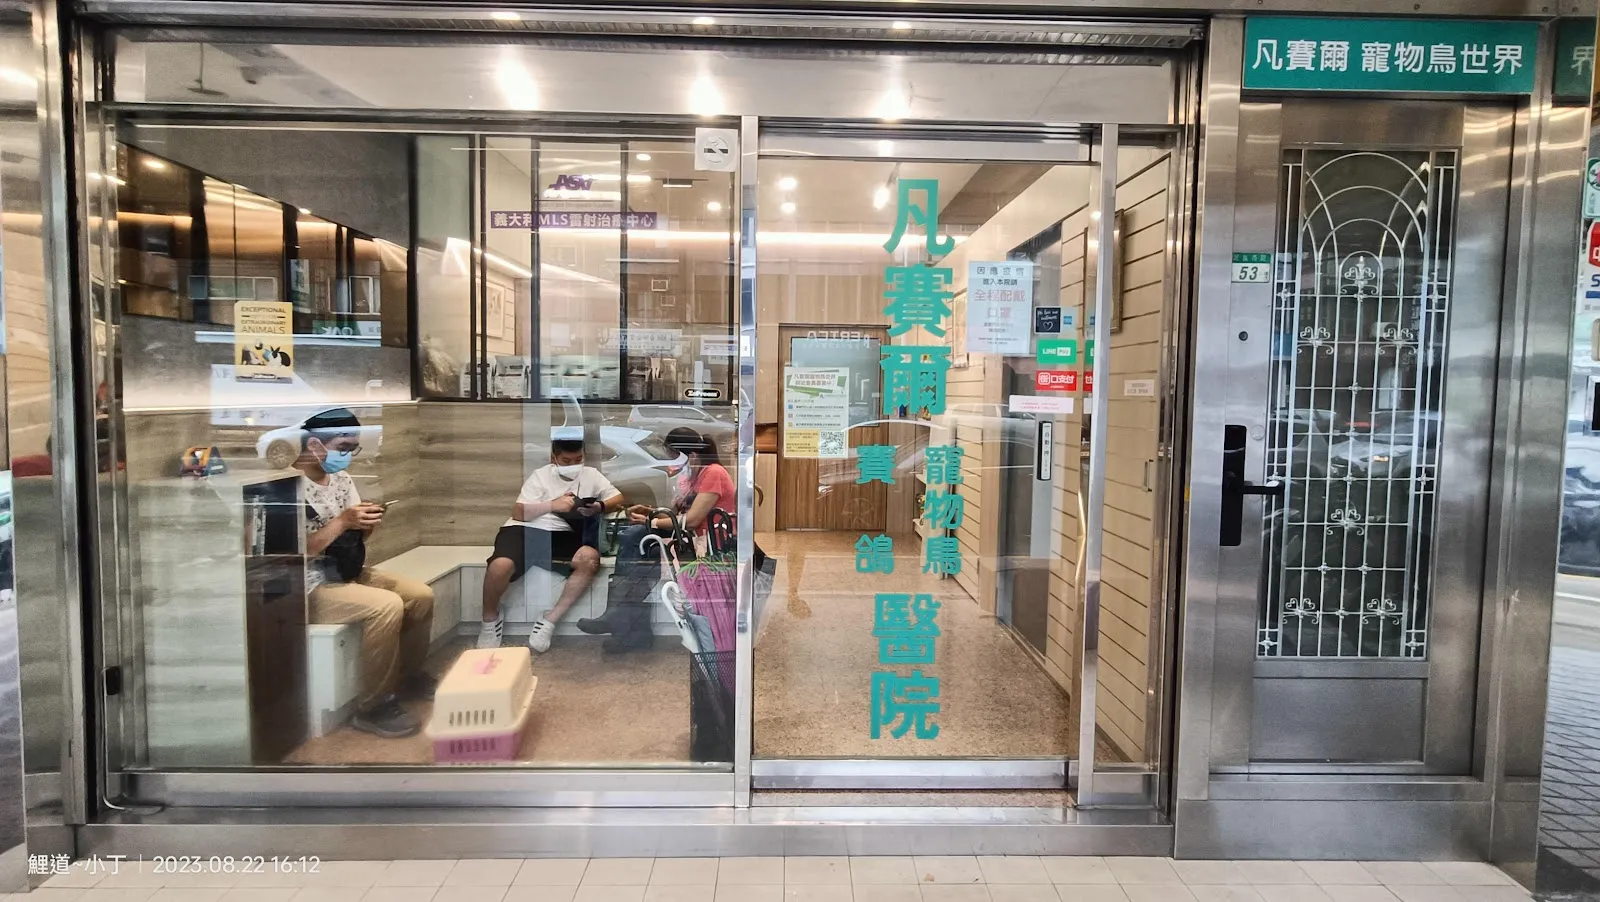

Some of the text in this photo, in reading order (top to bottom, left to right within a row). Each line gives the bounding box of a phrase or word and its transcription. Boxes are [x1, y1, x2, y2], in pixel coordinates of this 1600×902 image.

[1252, 38, 1523, 76] 凡賽爾 寵物鳥世界
[241, 326, 286, 334] ANIMALS
[878, 178, 956, 415] 凡賽爾
[1239, 266, 1259, 280] 53
[855, 444, 897, 575] 賽鴿
[922, 444, 965, 575] 寵物鳥
[870, 592, 942, 740] 醫院
